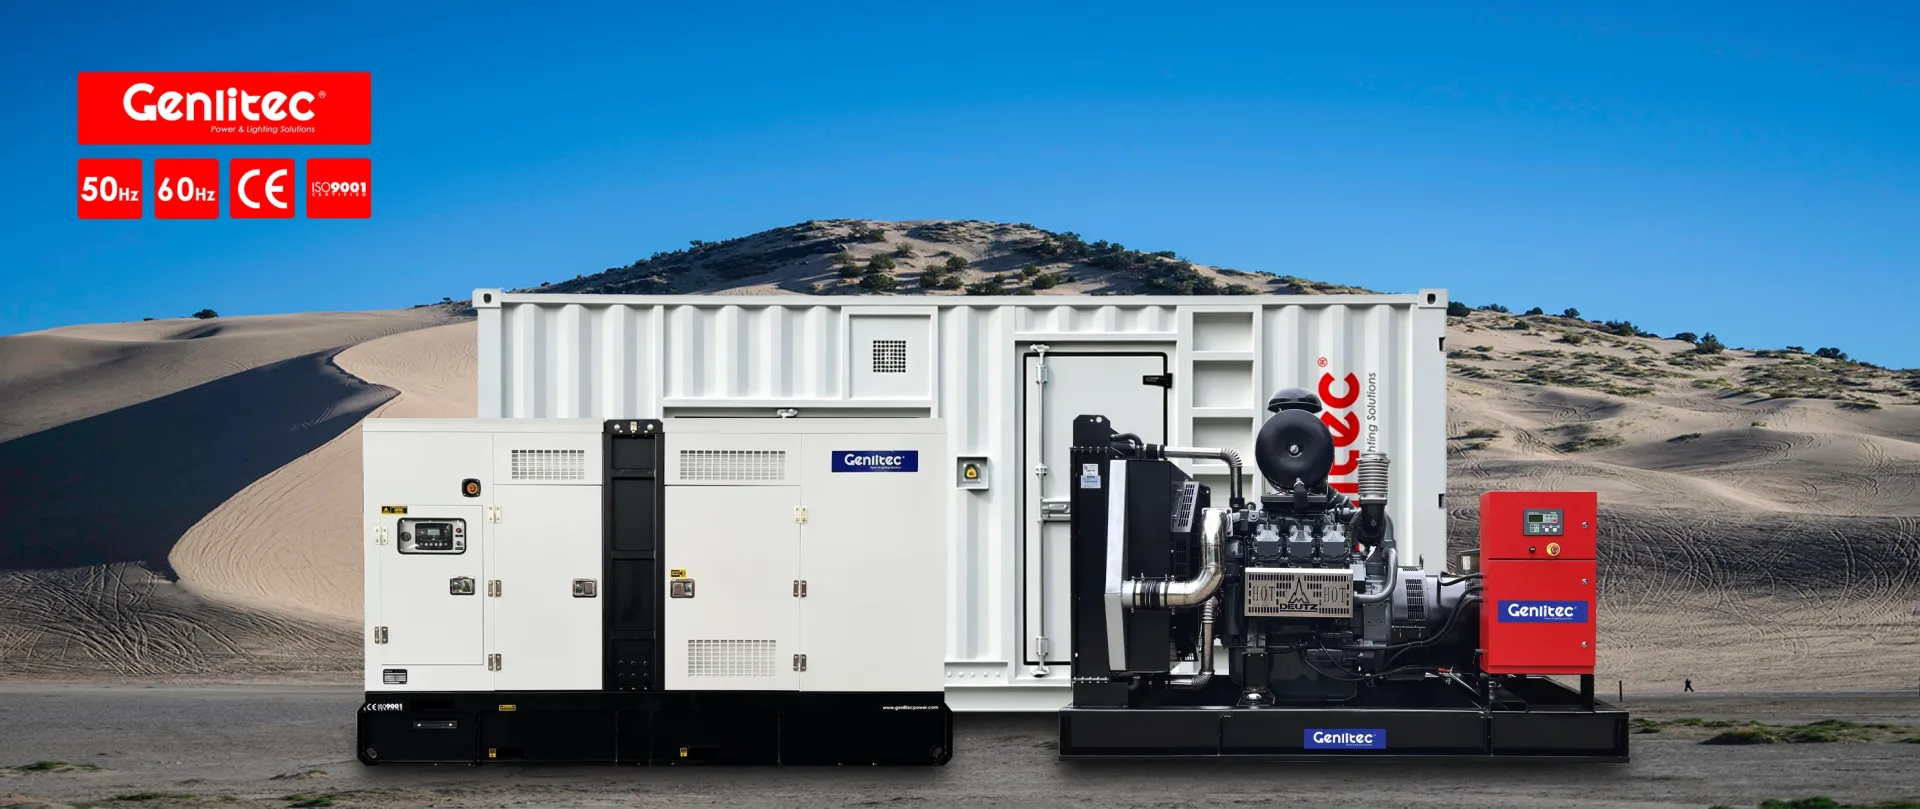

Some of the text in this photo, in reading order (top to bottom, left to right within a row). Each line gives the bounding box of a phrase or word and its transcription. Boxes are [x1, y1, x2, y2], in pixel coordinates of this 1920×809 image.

[1366, 372, 1377, 421] Solutions
[844, 453, 902, 466] Genlitec
[1252, 586, 1276, 602] HOT
[1323, 587, 1346, 602] HOT
[1507, 603, 1574, 617] Genlitec
[1313, 731, 1373, 744] Genlitec
